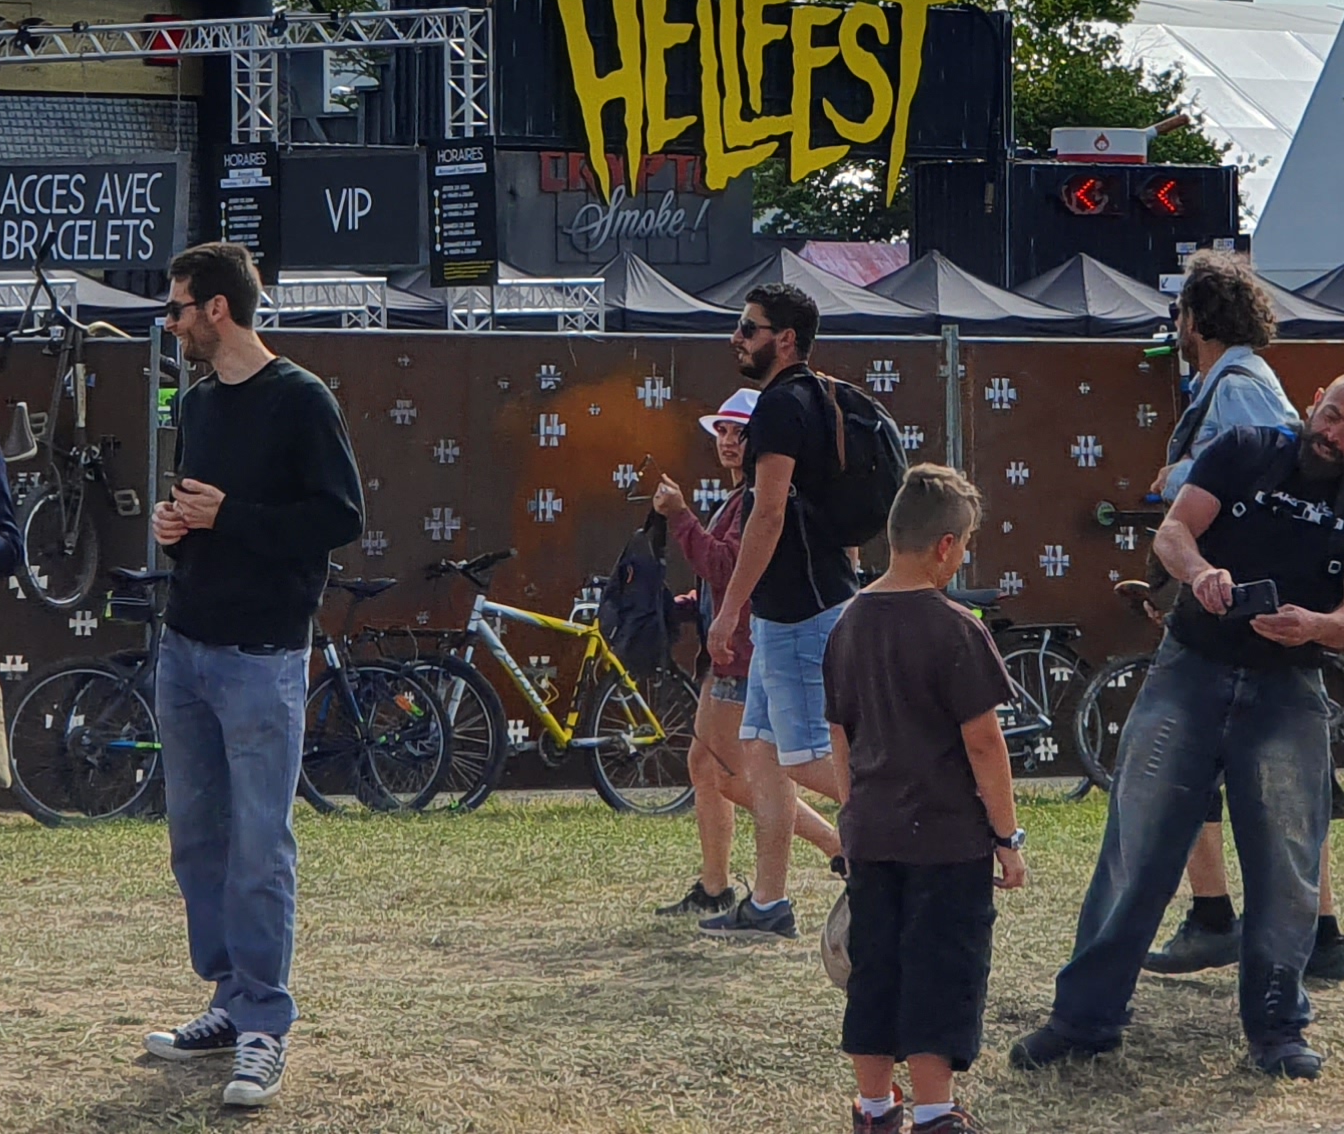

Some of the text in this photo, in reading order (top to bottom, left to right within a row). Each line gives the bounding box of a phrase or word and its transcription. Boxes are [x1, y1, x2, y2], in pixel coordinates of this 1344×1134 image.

[437, 147, 484, 163] HORAIRES
[0, 172, 163, 216] ACCES AVEC
[325, 187, 372, 233] VIP
[1, 218, 155, 260] BRACELETS
[562, 184, 687, 252] Smoke
